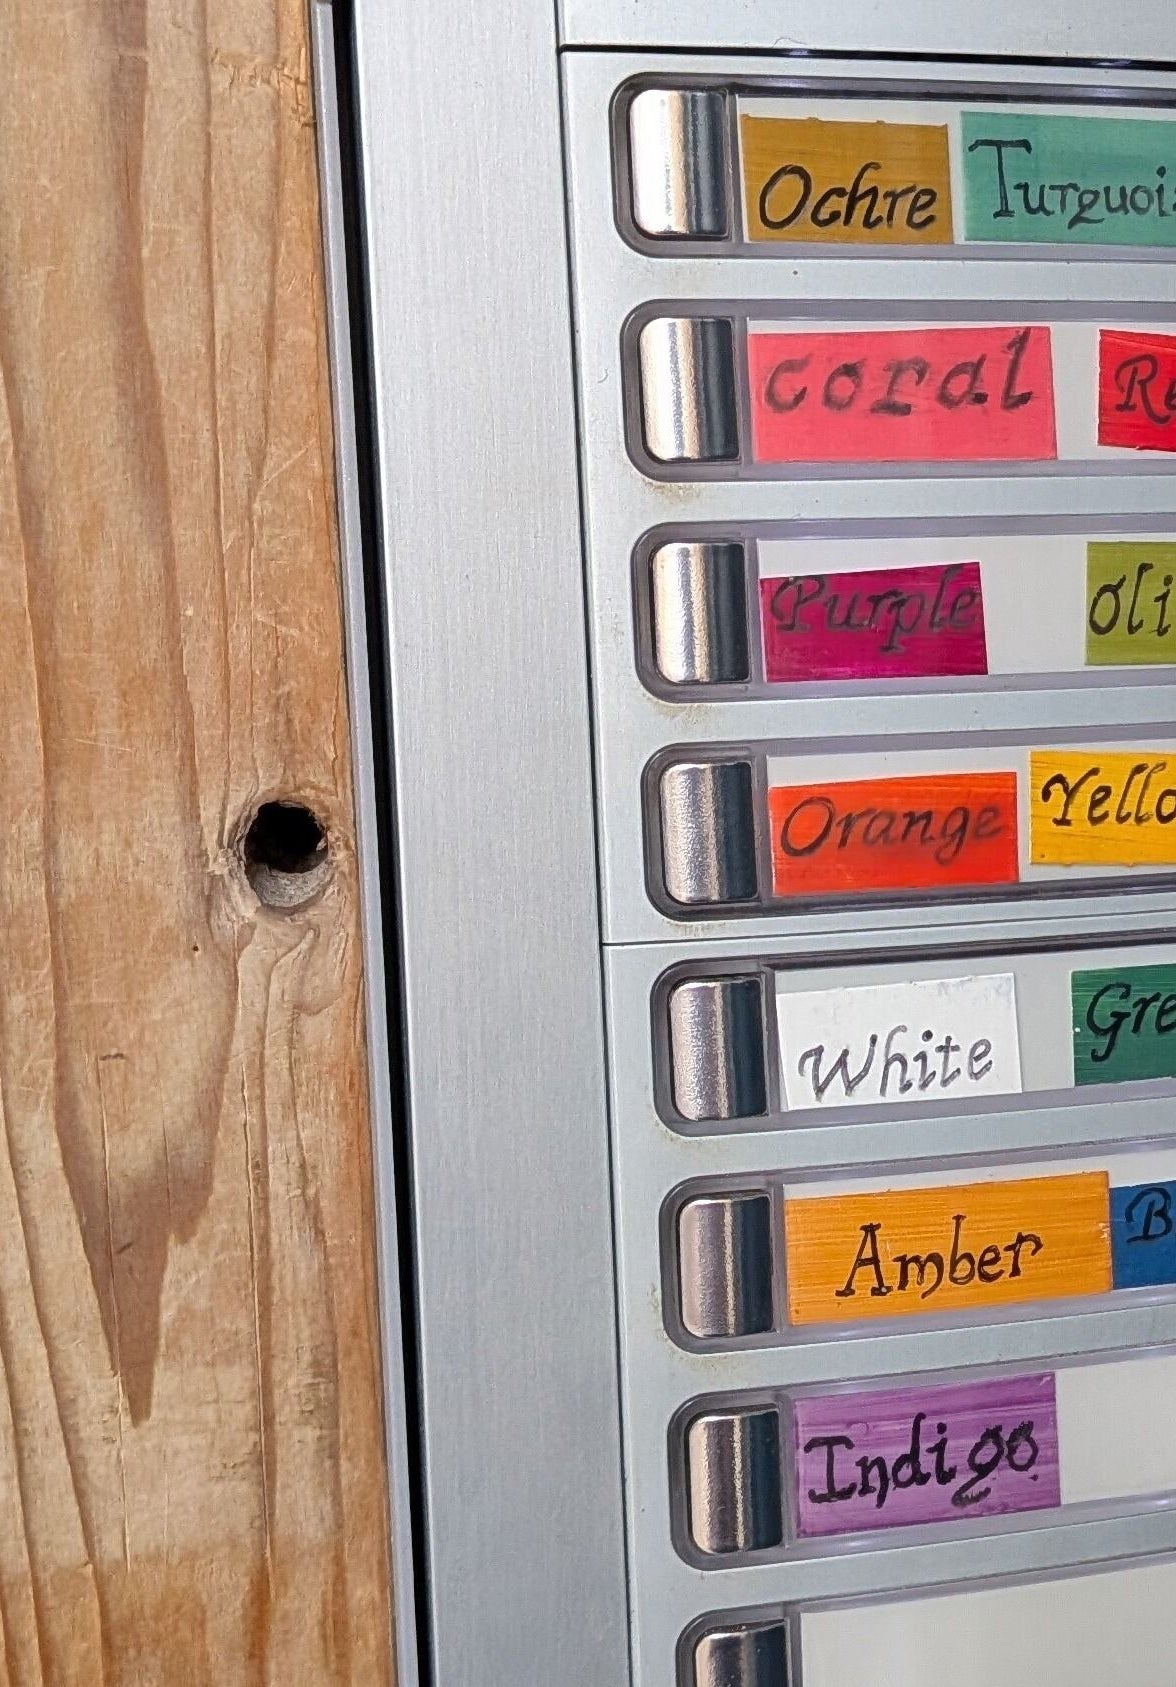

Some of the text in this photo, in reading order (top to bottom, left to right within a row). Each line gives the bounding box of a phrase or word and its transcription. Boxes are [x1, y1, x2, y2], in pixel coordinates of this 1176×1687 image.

[759, 162, 938, 230] Ochre
[770, 563, 982, 653] Purple
[780, 796, 1003, 864] Orange
[799, 1024, 994, 1102] White
[834, 1213, 1044, 1299] Amber
[803, 1412, 1039, 1508] Indigo
